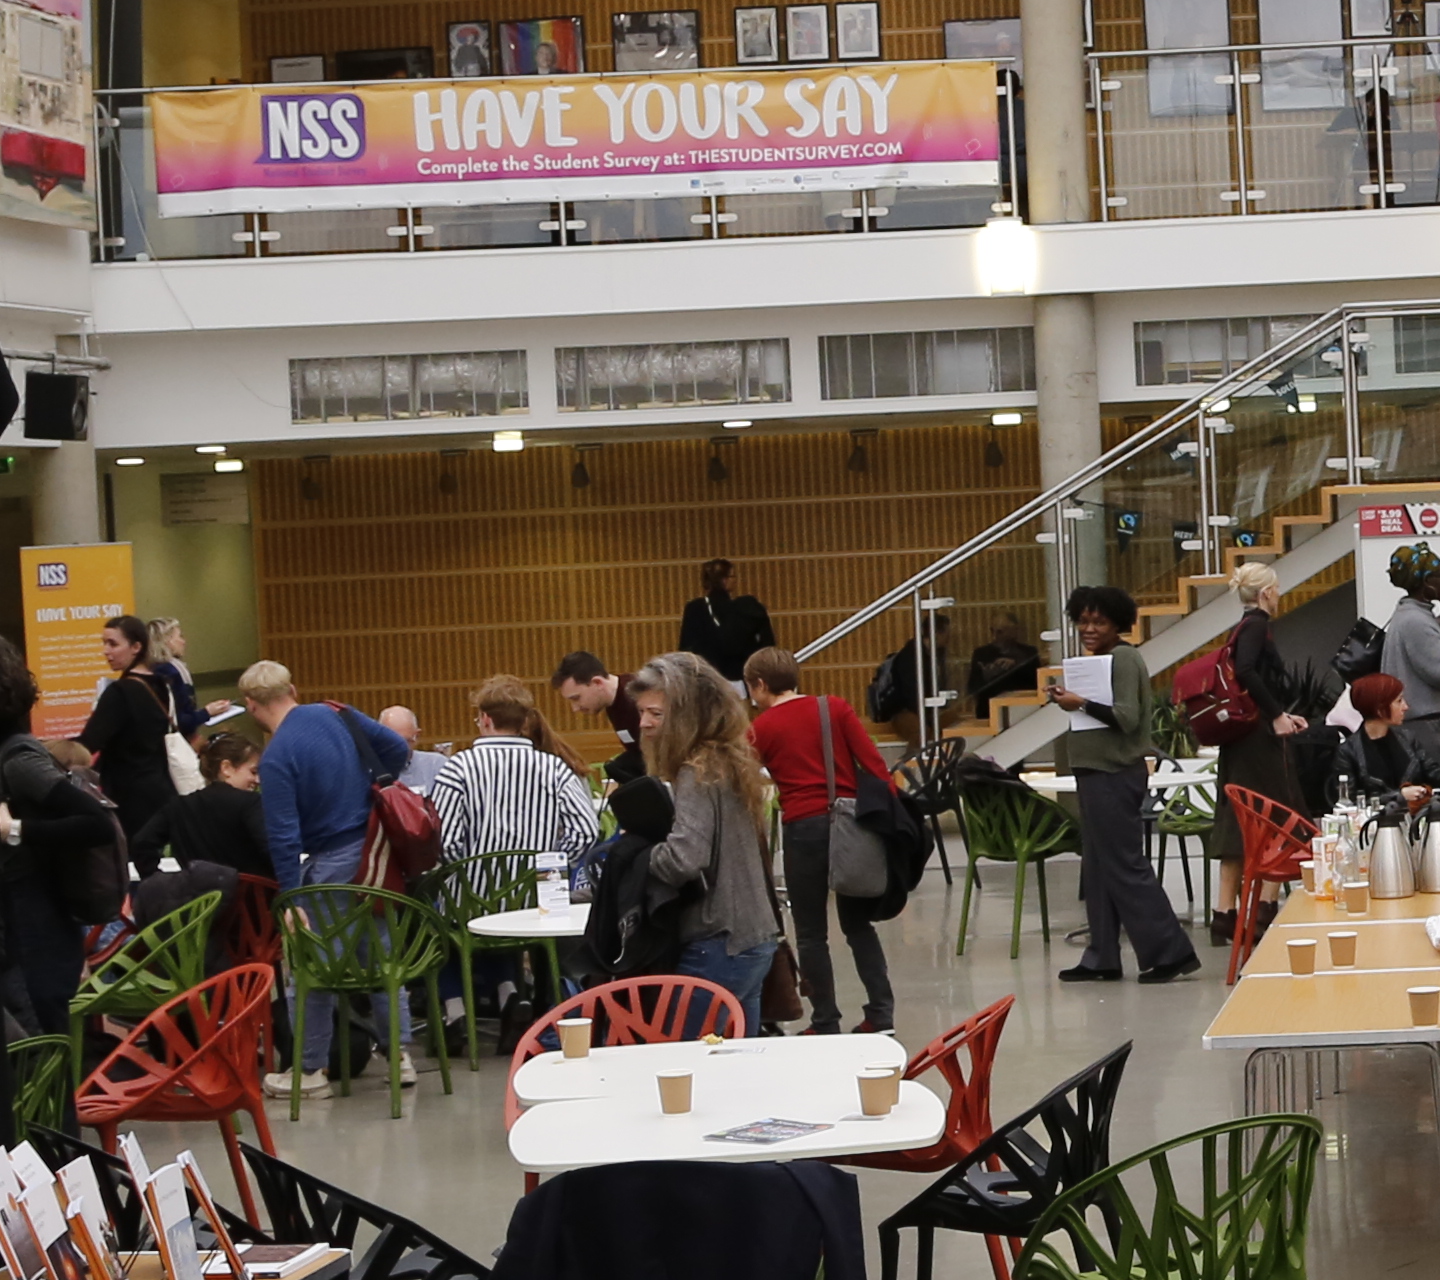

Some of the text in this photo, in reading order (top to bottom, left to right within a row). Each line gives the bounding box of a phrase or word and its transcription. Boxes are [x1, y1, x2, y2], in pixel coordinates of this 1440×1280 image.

[266, 98, 361, 160] NSS
[413, 73, 899, 152] HAVE YOUR SAY
[417, 140, 903, 179] Complete the Student Survey at: THESTUDENTSURVEY.COM
[39, 564, 67, 586] NSS
[36, 604, 123, 622] HAVE YOUR SAY
